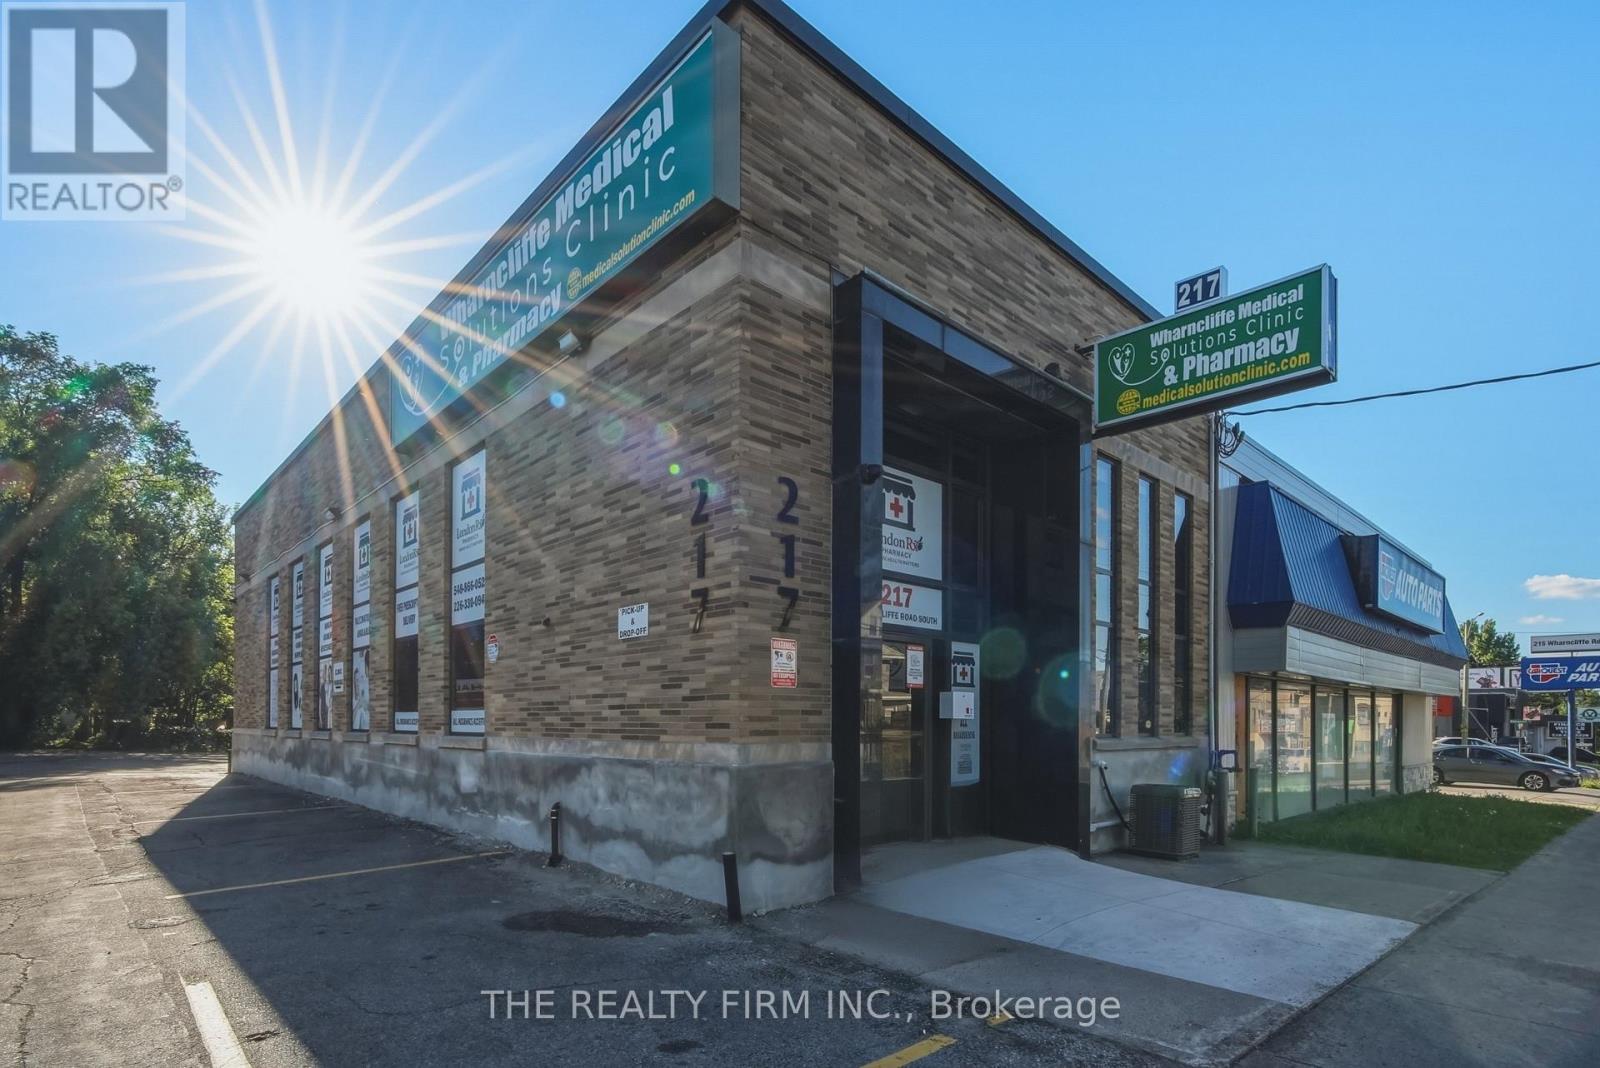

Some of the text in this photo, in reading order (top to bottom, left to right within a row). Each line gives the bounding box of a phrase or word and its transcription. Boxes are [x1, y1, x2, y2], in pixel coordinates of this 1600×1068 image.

[441, 85, 674, 341] Wharncliffe Medical
[440, 146, 675, 372] Solutions Clinic
[581, 188, 695, 288] medicalsolutionclinic.com
[1178, 272, 1220, 308] 217
[458, 281, 562, 388] & Pharmacy
[1150, 283, 1304, 348] Wharncliffe Medical
[1150, 305, 1304, 367] Solutions Clinic
[1163, 327, 1300, 386] & Pharmacy
[1143, 351, 1310, 409] medicalsolutionclinic.com
[882, 547, 912, 560] HARMACY
[621, 604, 645, 616] PICK-UP
[881, 584, 913, 608] 217
[1395, 569, 1418, 608] AUTO
[1418, 581, 1442, 618] PARTS
[619, 626, 647, 638] DROP-OFF
[900, 612, 918, 622] ROAD
[919, 615, 938, 625] SOUTH
[1548, 639, 1590, 647] Wharncliffe
[1567, 672, 1600, 683] PAR
[1575, 662, 1600, 673] AU
